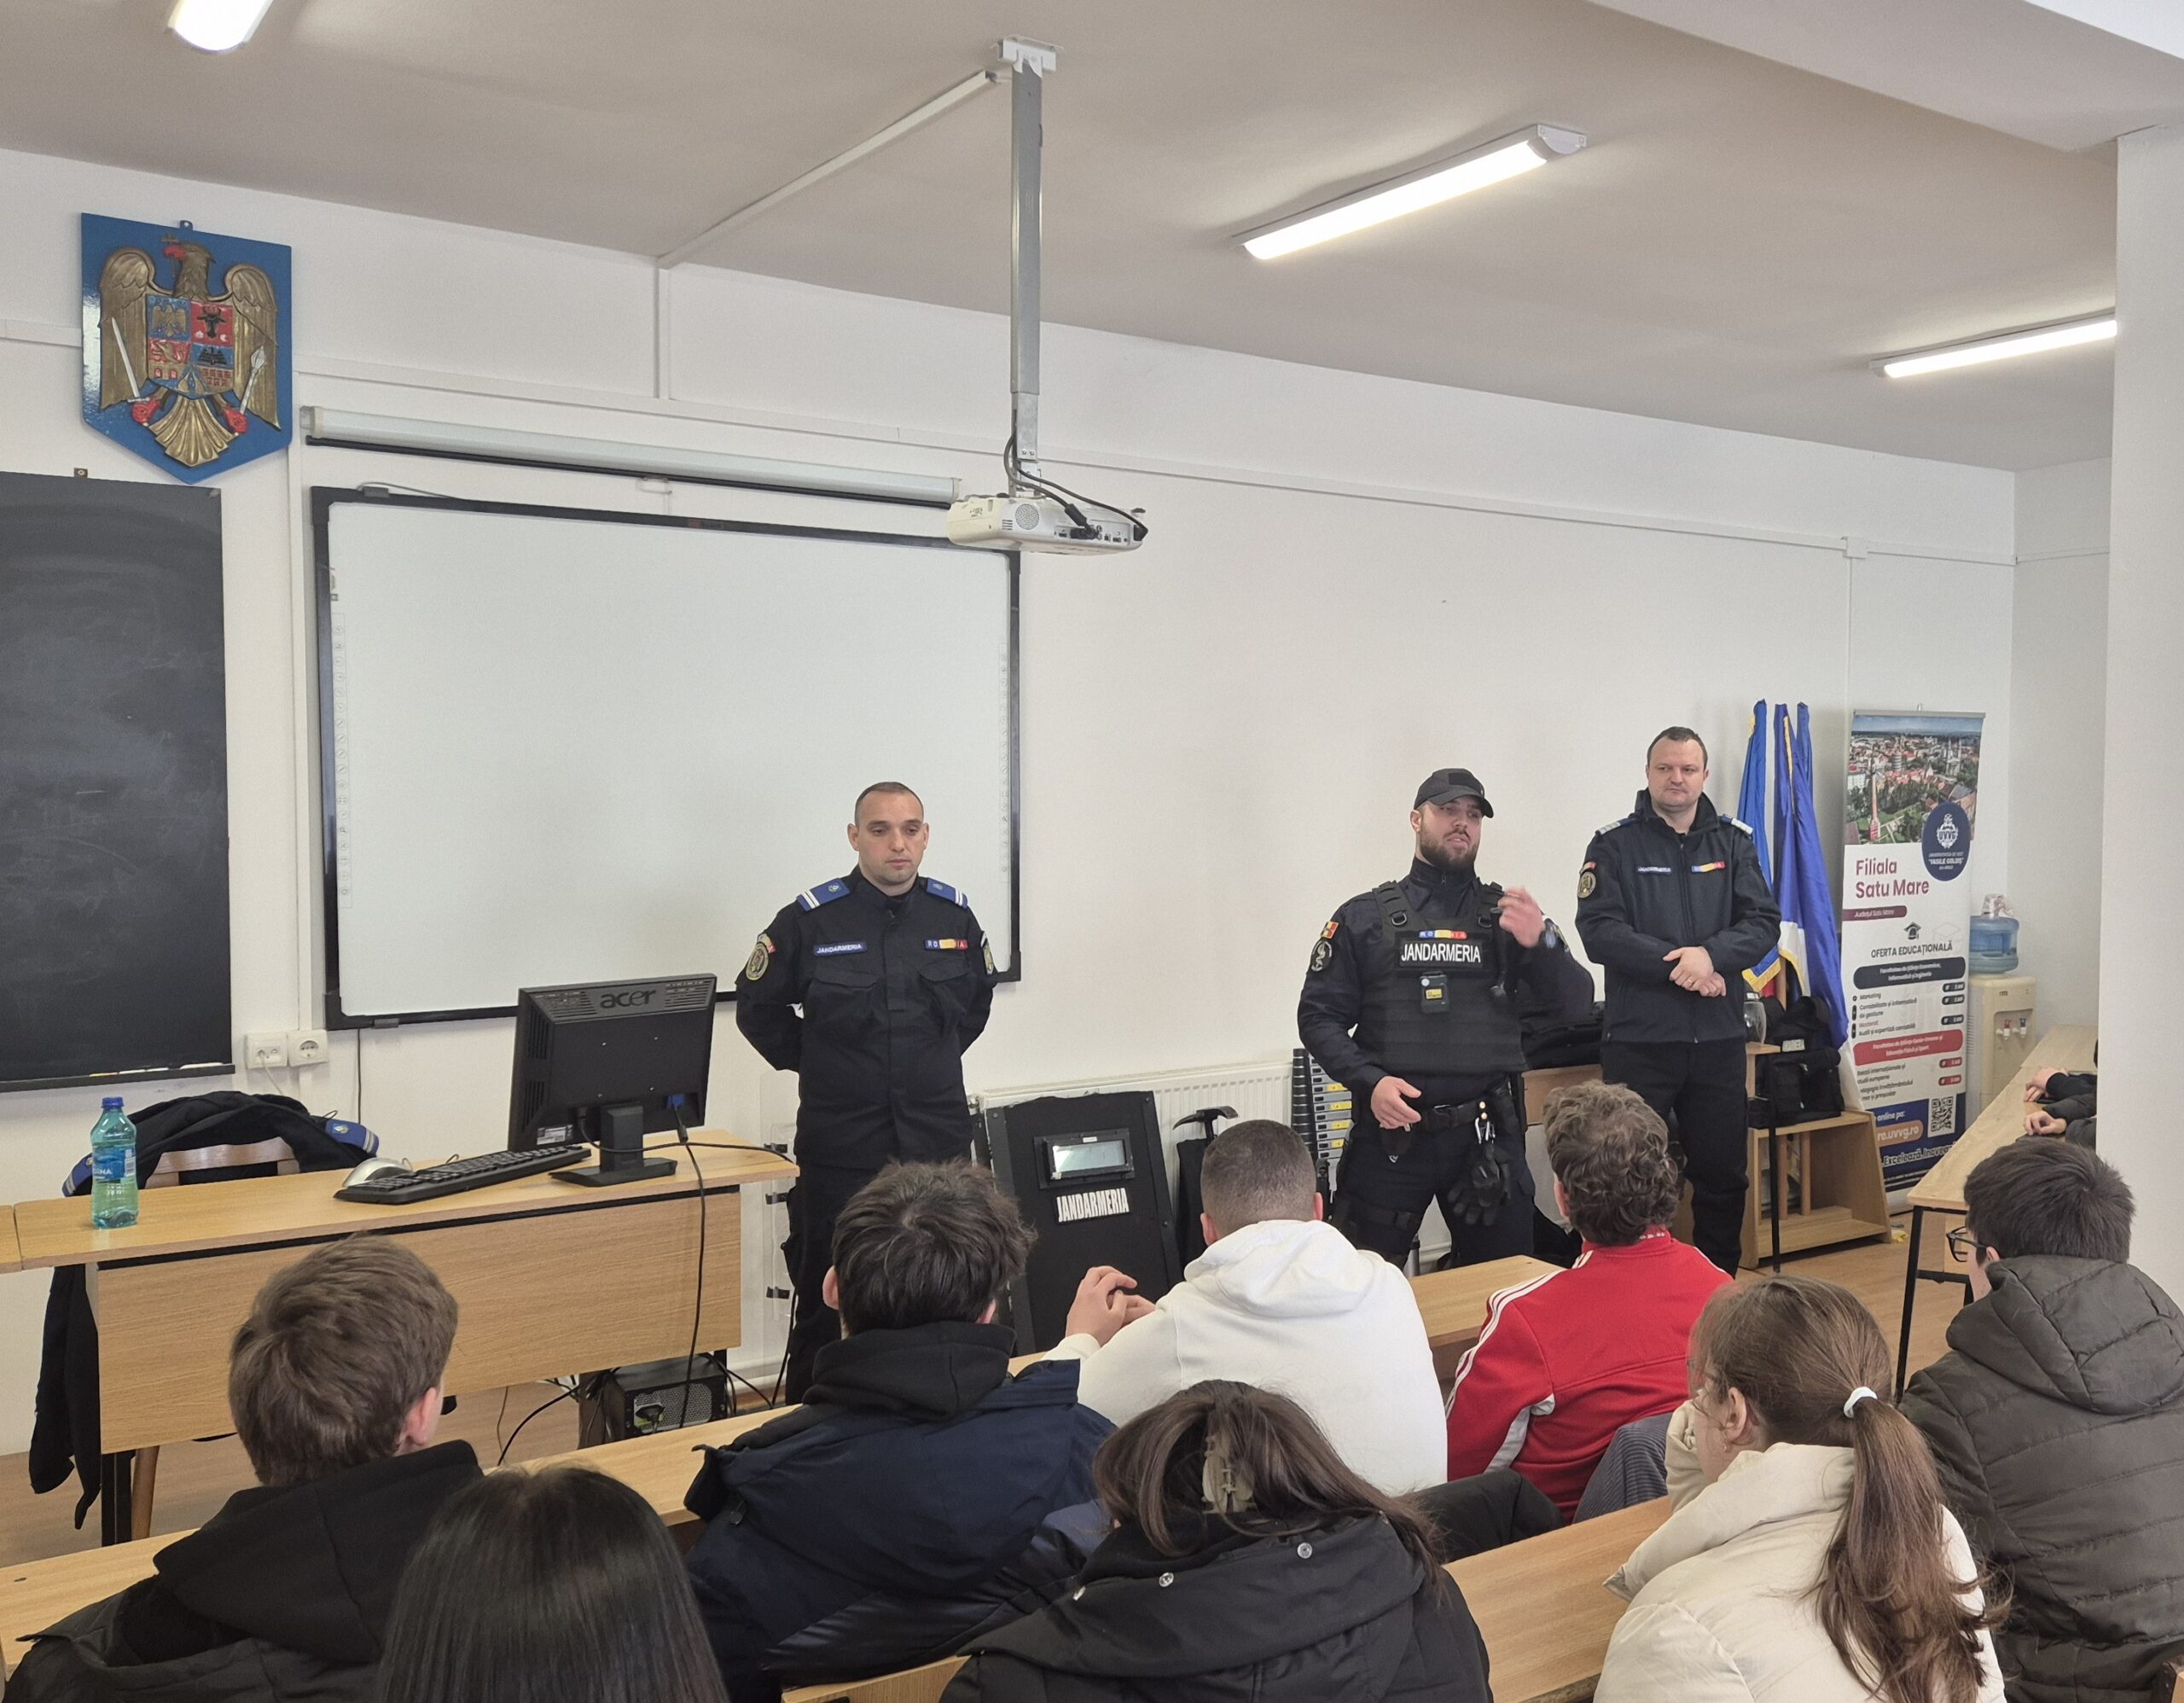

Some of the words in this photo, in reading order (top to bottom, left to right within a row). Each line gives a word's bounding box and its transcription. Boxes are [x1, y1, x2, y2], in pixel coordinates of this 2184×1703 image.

[1856, 857, 1897, 875] Filiala
[1856, 881, 1890, 898] Satu
[1893, 879, 1929, 895] Mare
[1401, 943, 1481, 963] JANDARMERIA
[1871, 947, 1896, 957] OFERTA
[600, 990, 656, 1009] acer
[1877, 1112, 1896, 1121] online
[1877, 1126, 1919, 1142] re.uvvg.ro
[1056, 1188, 1130, 1223] JANDARMERIA
